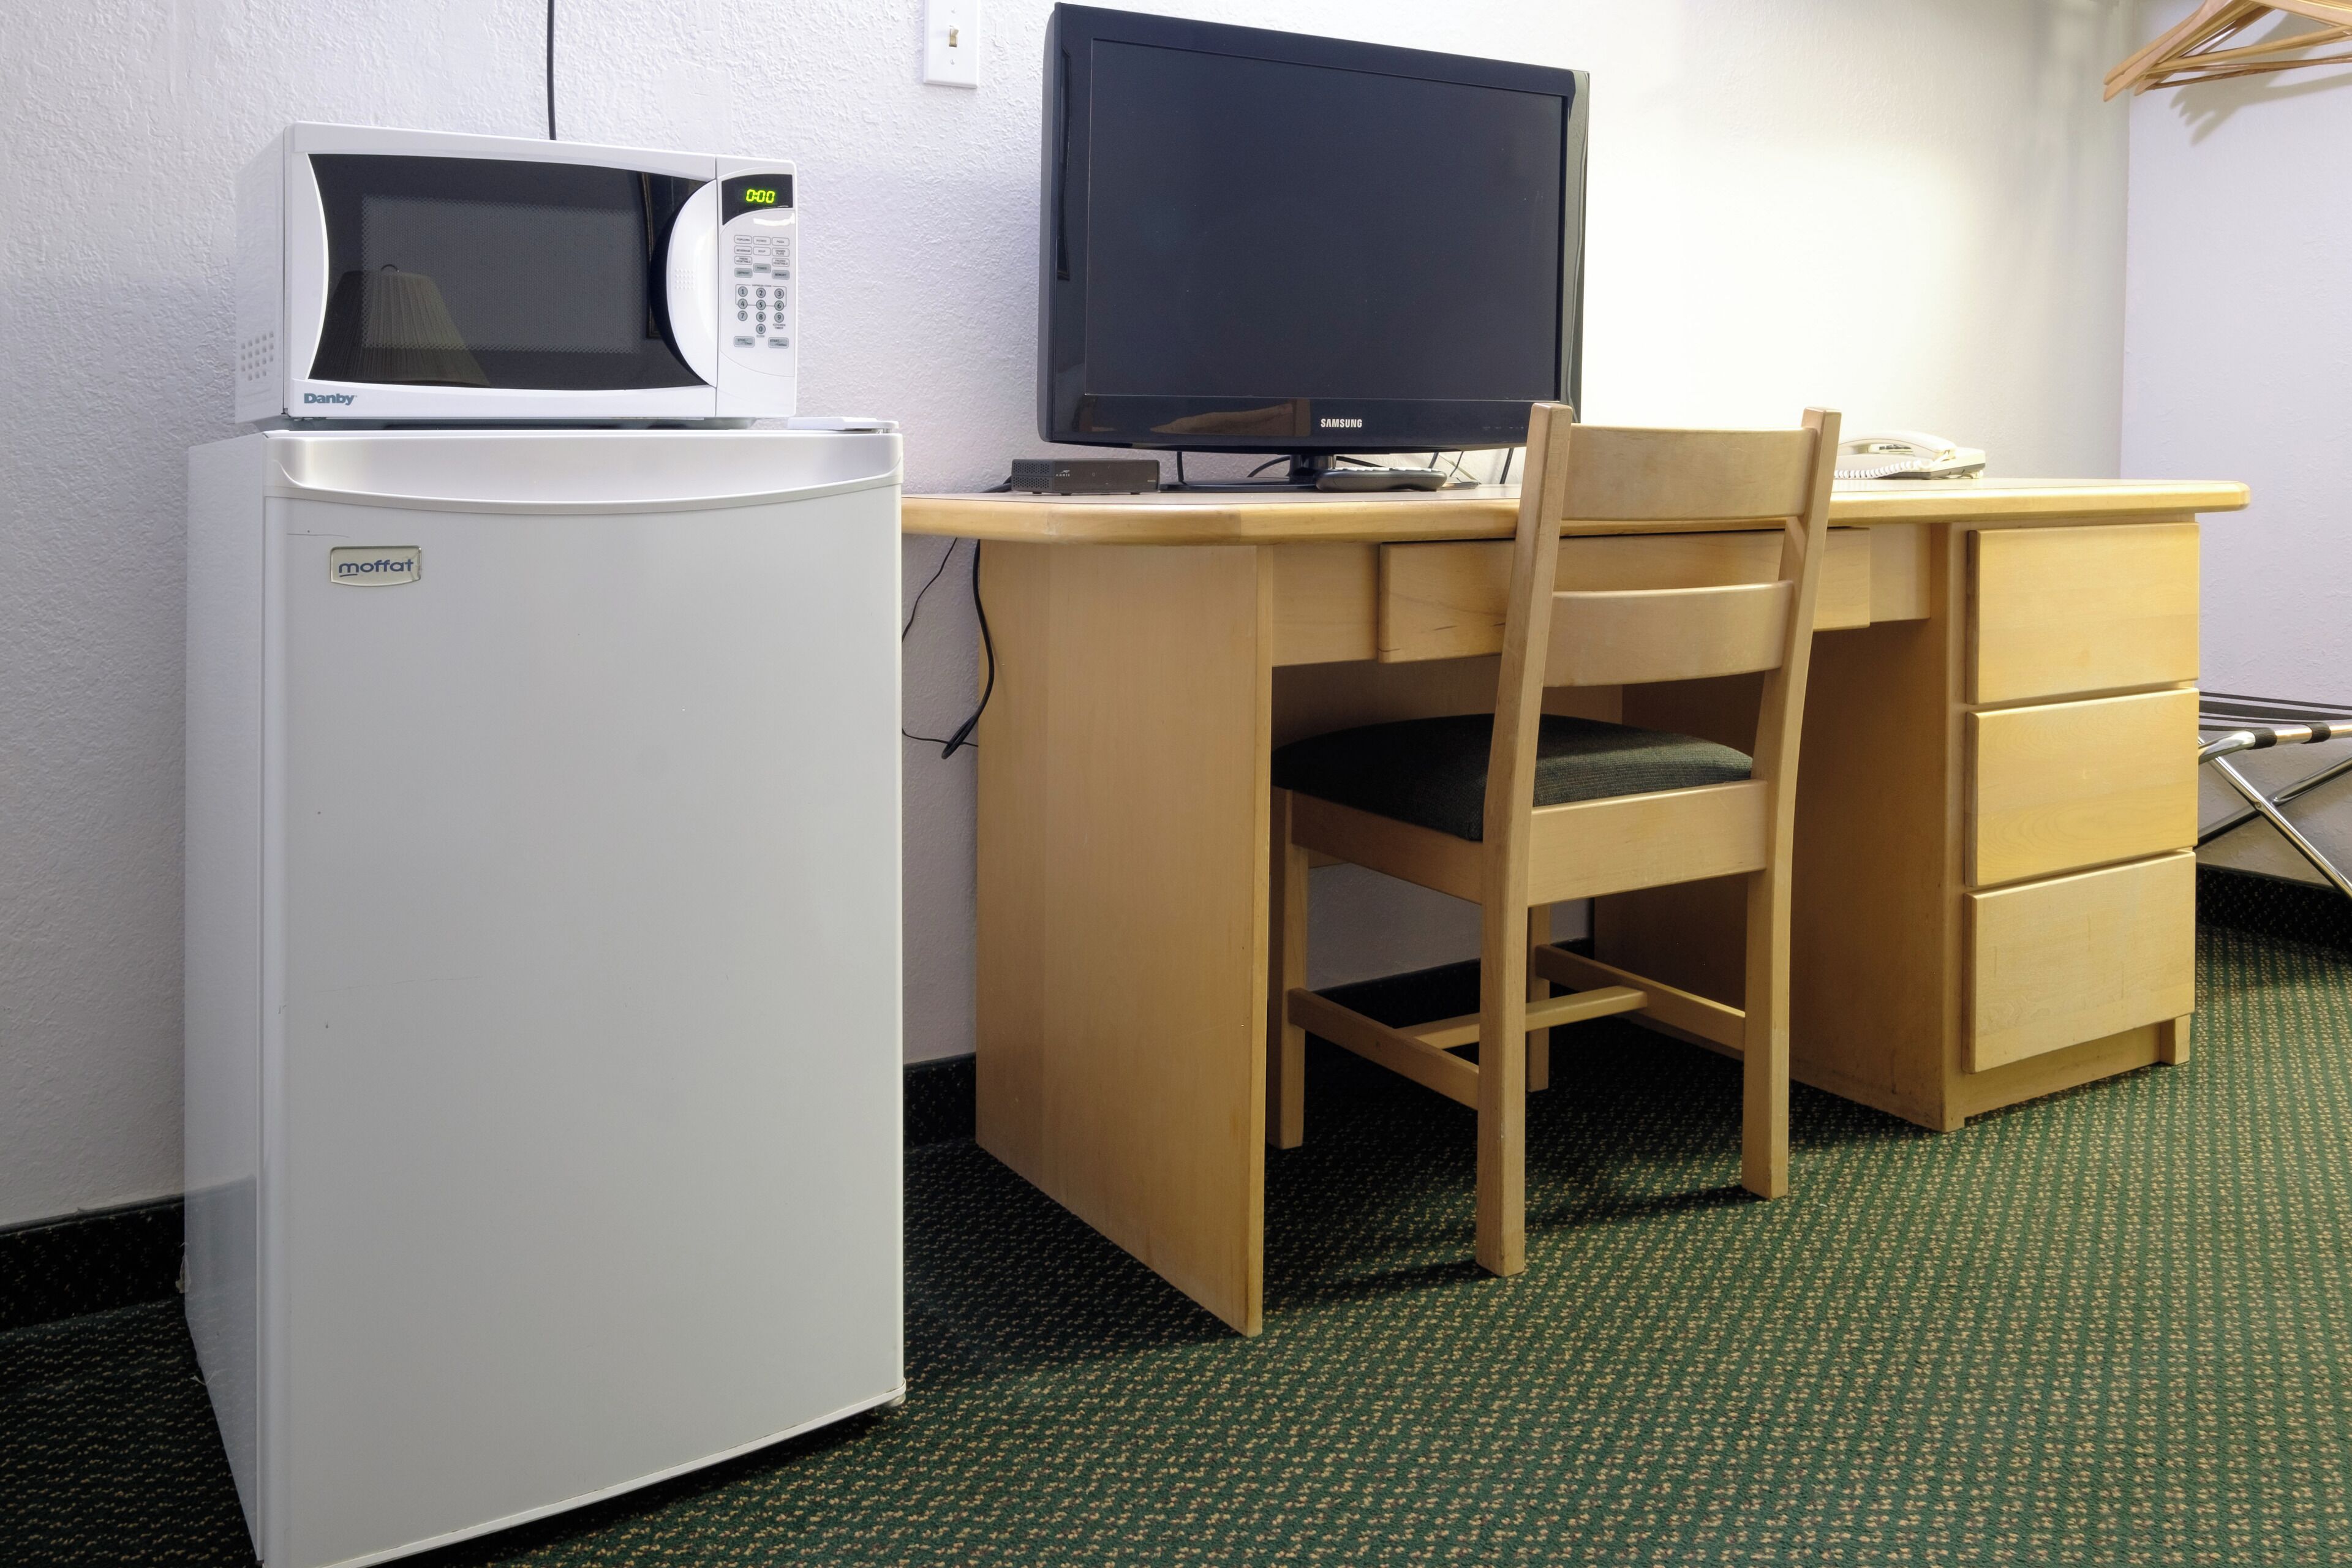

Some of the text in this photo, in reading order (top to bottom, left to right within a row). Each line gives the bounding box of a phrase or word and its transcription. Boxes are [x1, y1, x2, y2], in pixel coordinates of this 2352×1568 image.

[746, 189, 775, 203] 0:00
[304, 393, 355, 405] Danby
[1321, 418, 1362, 428] SAMSUNG
[338, 559, 414, 573] moffat
